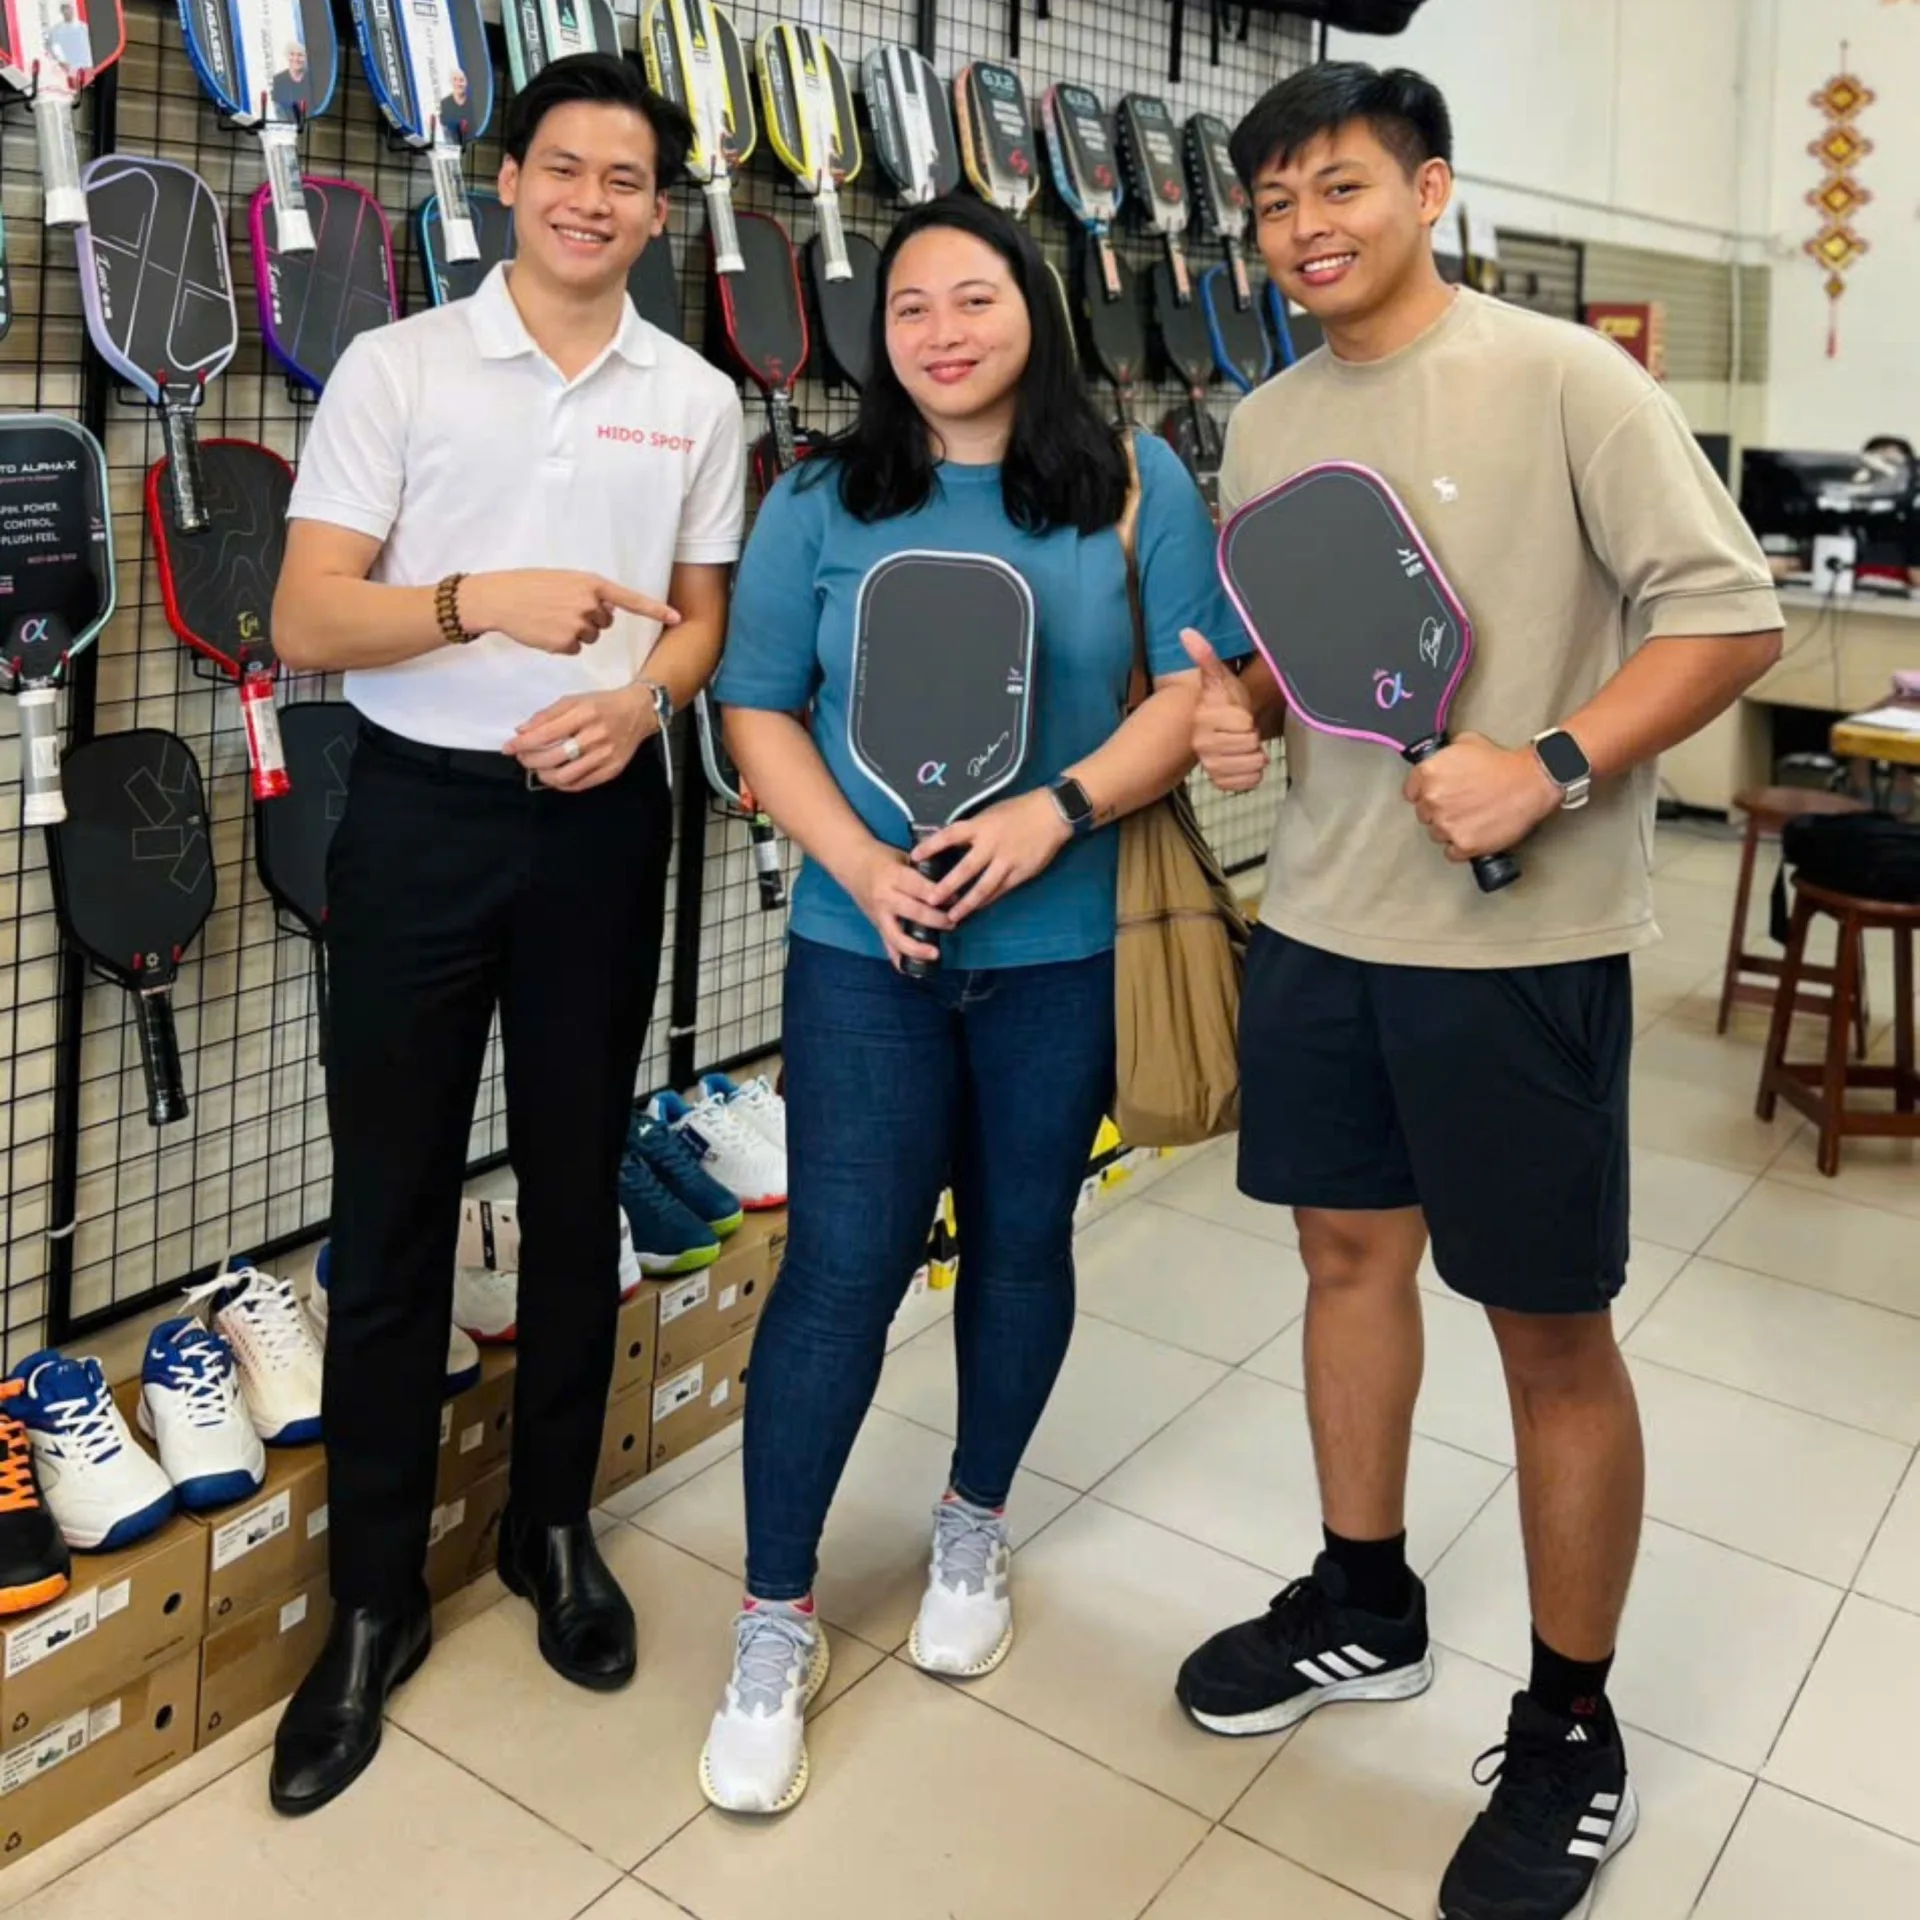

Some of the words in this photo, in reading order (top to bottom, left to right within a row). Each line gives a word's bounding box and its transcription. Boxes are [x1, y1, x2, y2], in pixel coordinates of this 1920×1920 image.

[597, 425, 645, 444] HIDO
[650, 432, 697, 455] SPOT
[21, 460, 78, 473] ALPHA-X
